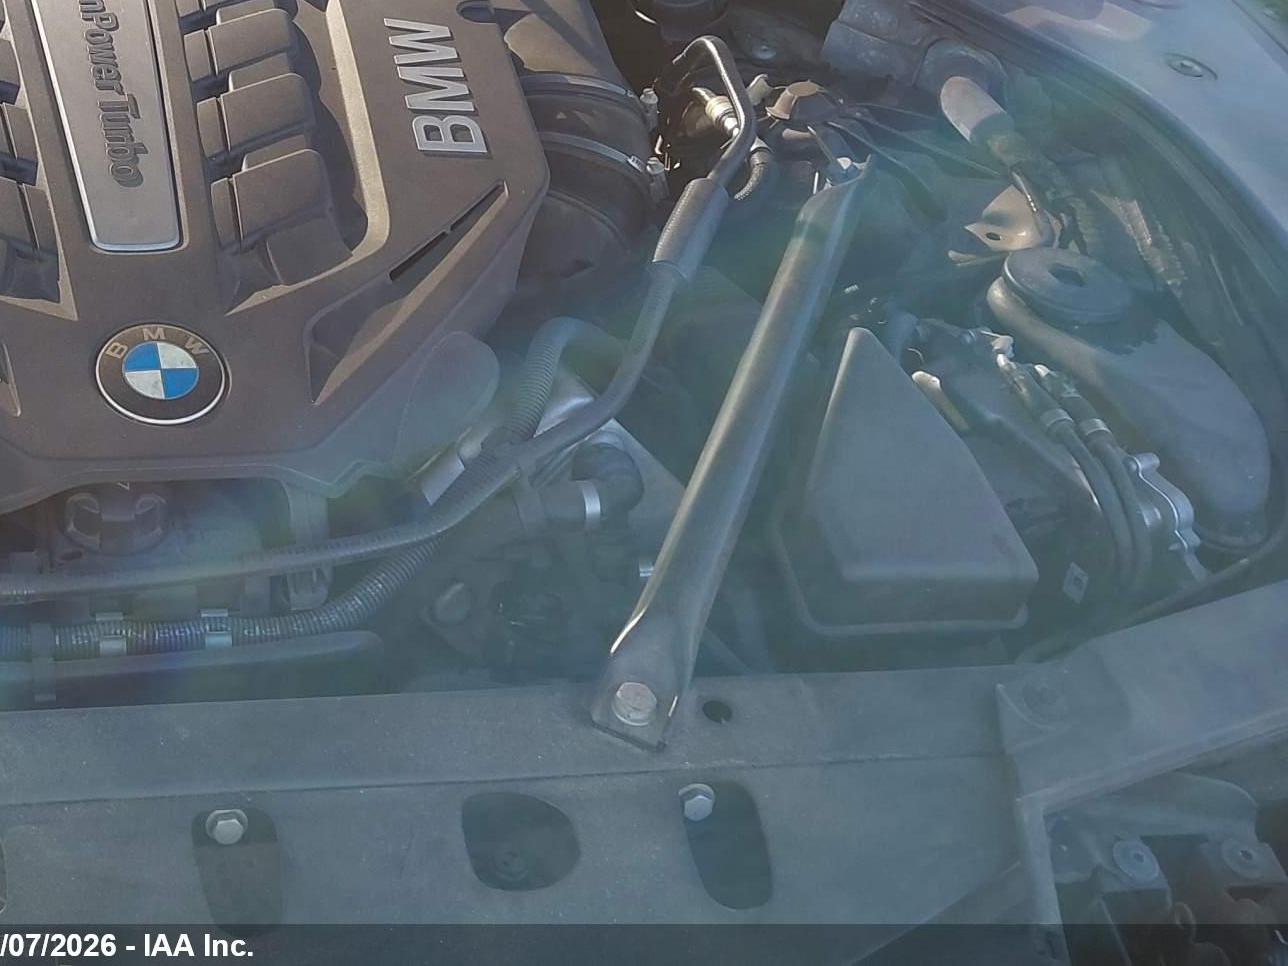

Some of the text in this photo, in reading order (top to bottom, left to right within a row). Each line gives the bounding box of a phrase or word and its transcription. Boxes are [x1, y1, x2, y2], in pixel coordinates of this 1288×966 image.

[383, 17, 488, 153] BMW
[97, 92, 148, 187] Turbo
[106, 327, 210, 360] BMW
